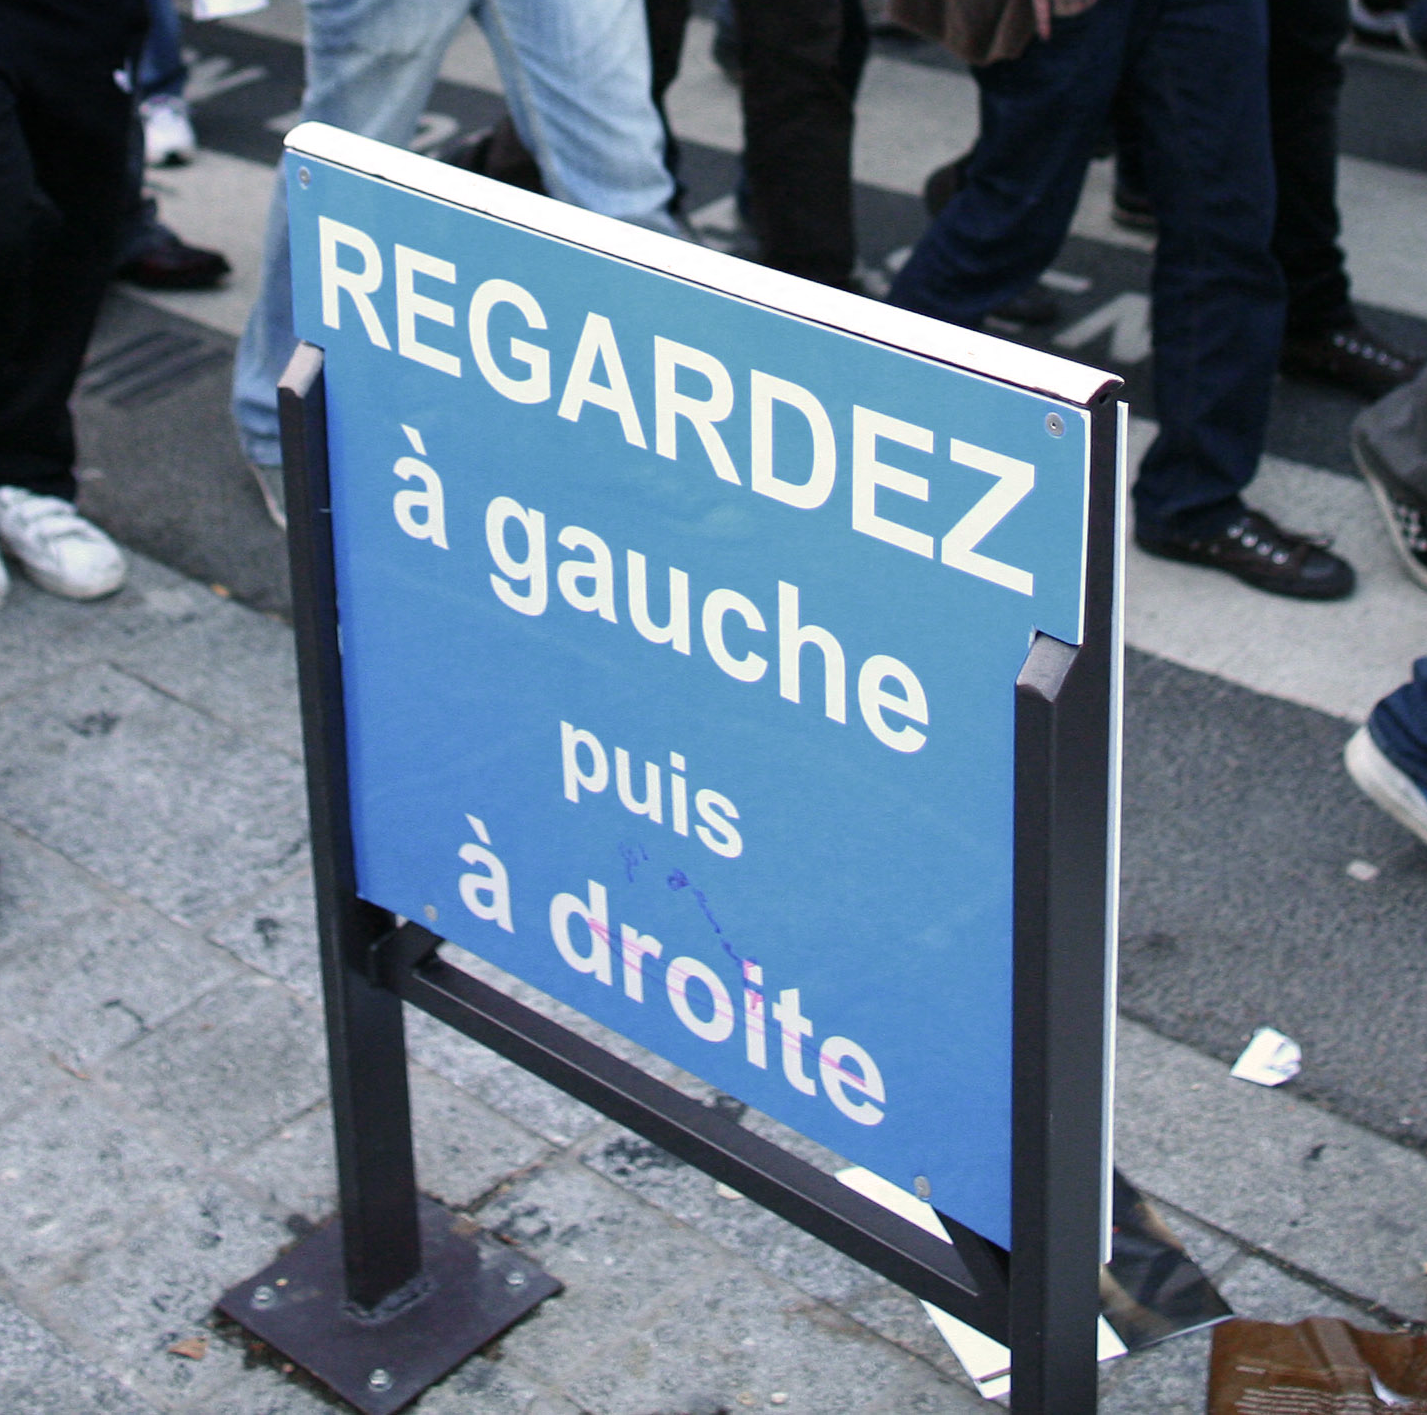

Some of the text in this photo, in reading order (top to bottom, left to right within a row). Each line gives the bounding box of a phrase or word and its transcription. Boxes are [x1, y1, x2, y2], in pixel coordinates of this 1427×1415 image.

[319, 216, 1035, 596] REGARDEZ
[393, 424, 928, 754] à gauche
[560, 720, 743, 859] puis
[458, 814, 514, 933] à
[549, 879, 886, 1126] droite
